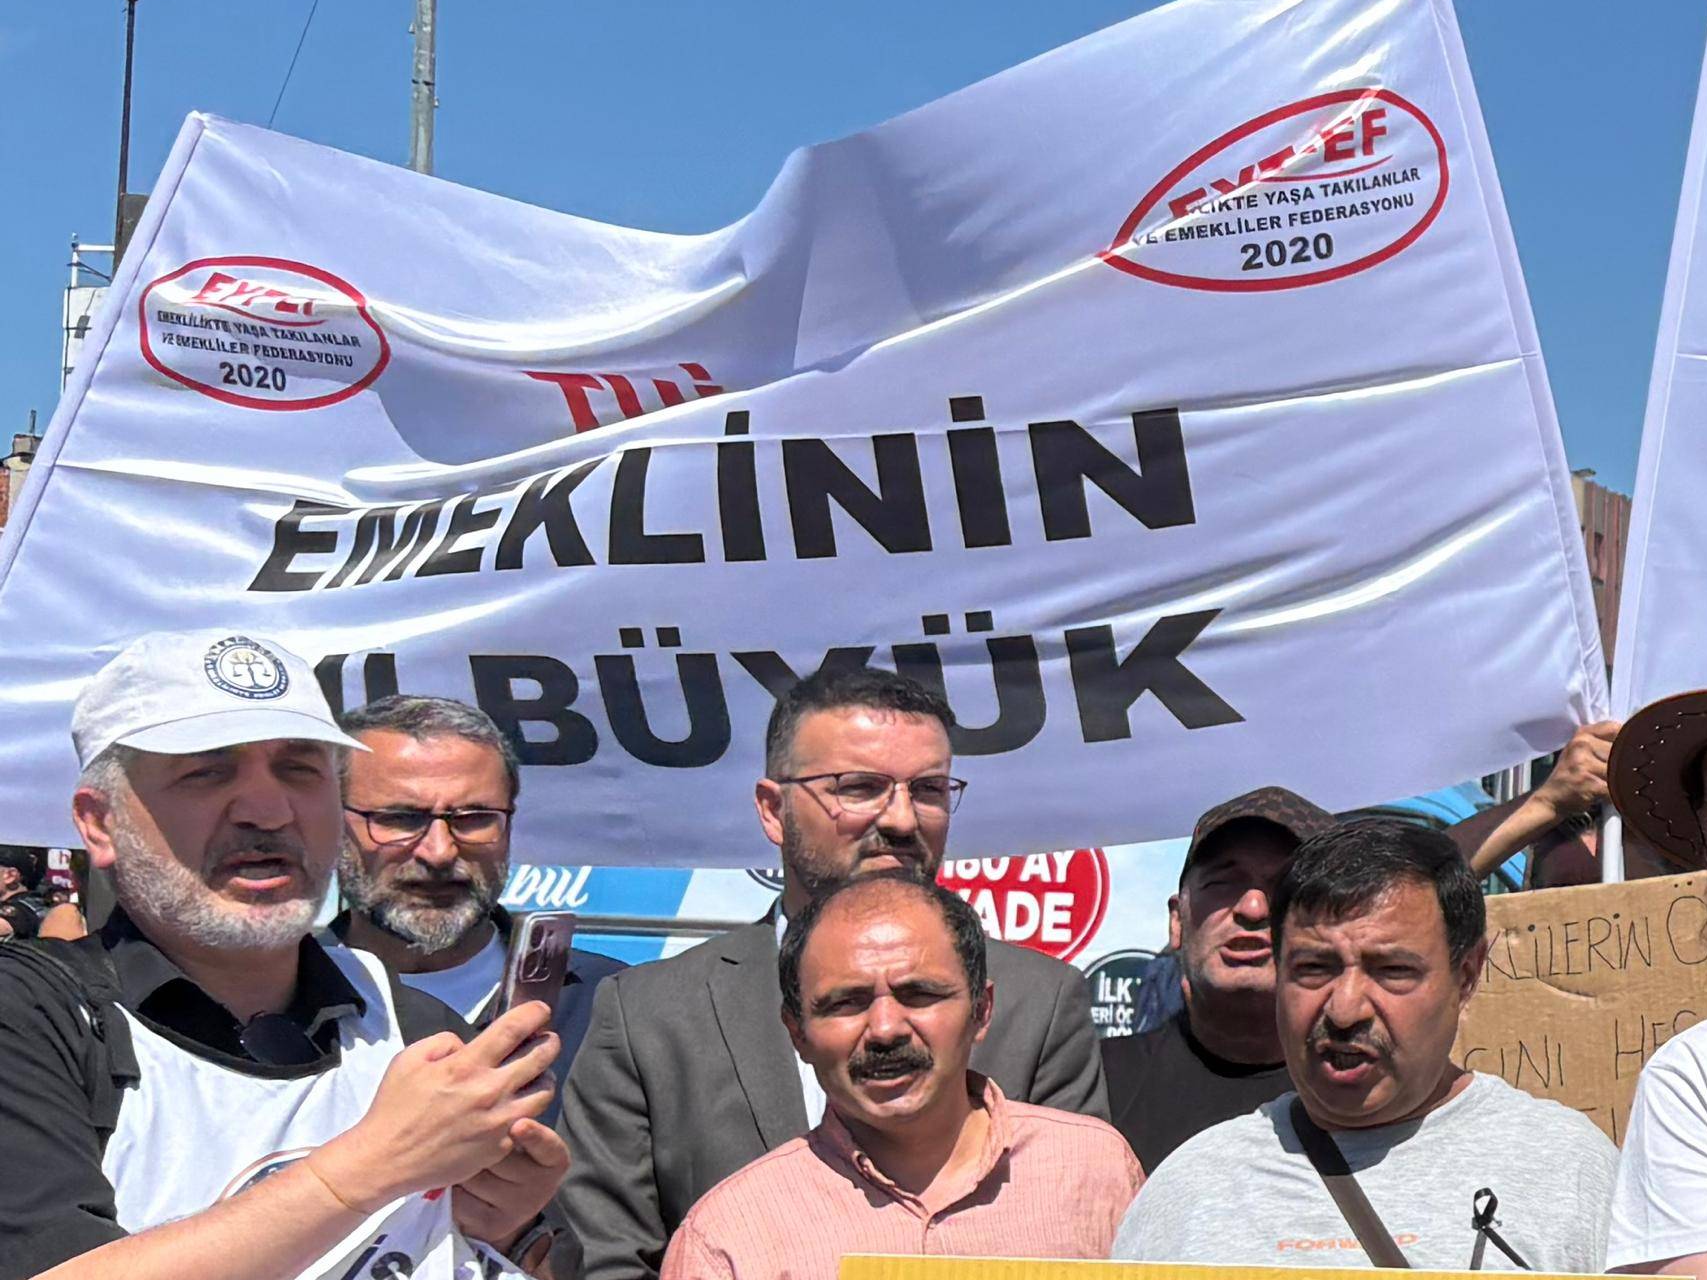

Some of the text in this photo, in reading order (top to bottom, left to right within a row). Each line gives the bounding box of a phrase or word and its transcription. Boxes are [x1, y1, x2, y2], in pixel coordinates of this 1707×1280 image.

[1264, 187, 1315, 207] YAŞA
[1319, 167, 1421, 197] TAKILANLAR
[1165, 217, 1282, 242] EMEKLİLER
[1288, 192, 1414, 228] FEDERASYONU
[1240, 232, 1334, 271] 2020
[219, 361, 286, 392] 2020
[247, 396, 1197, 593] EMEKLİNİN
